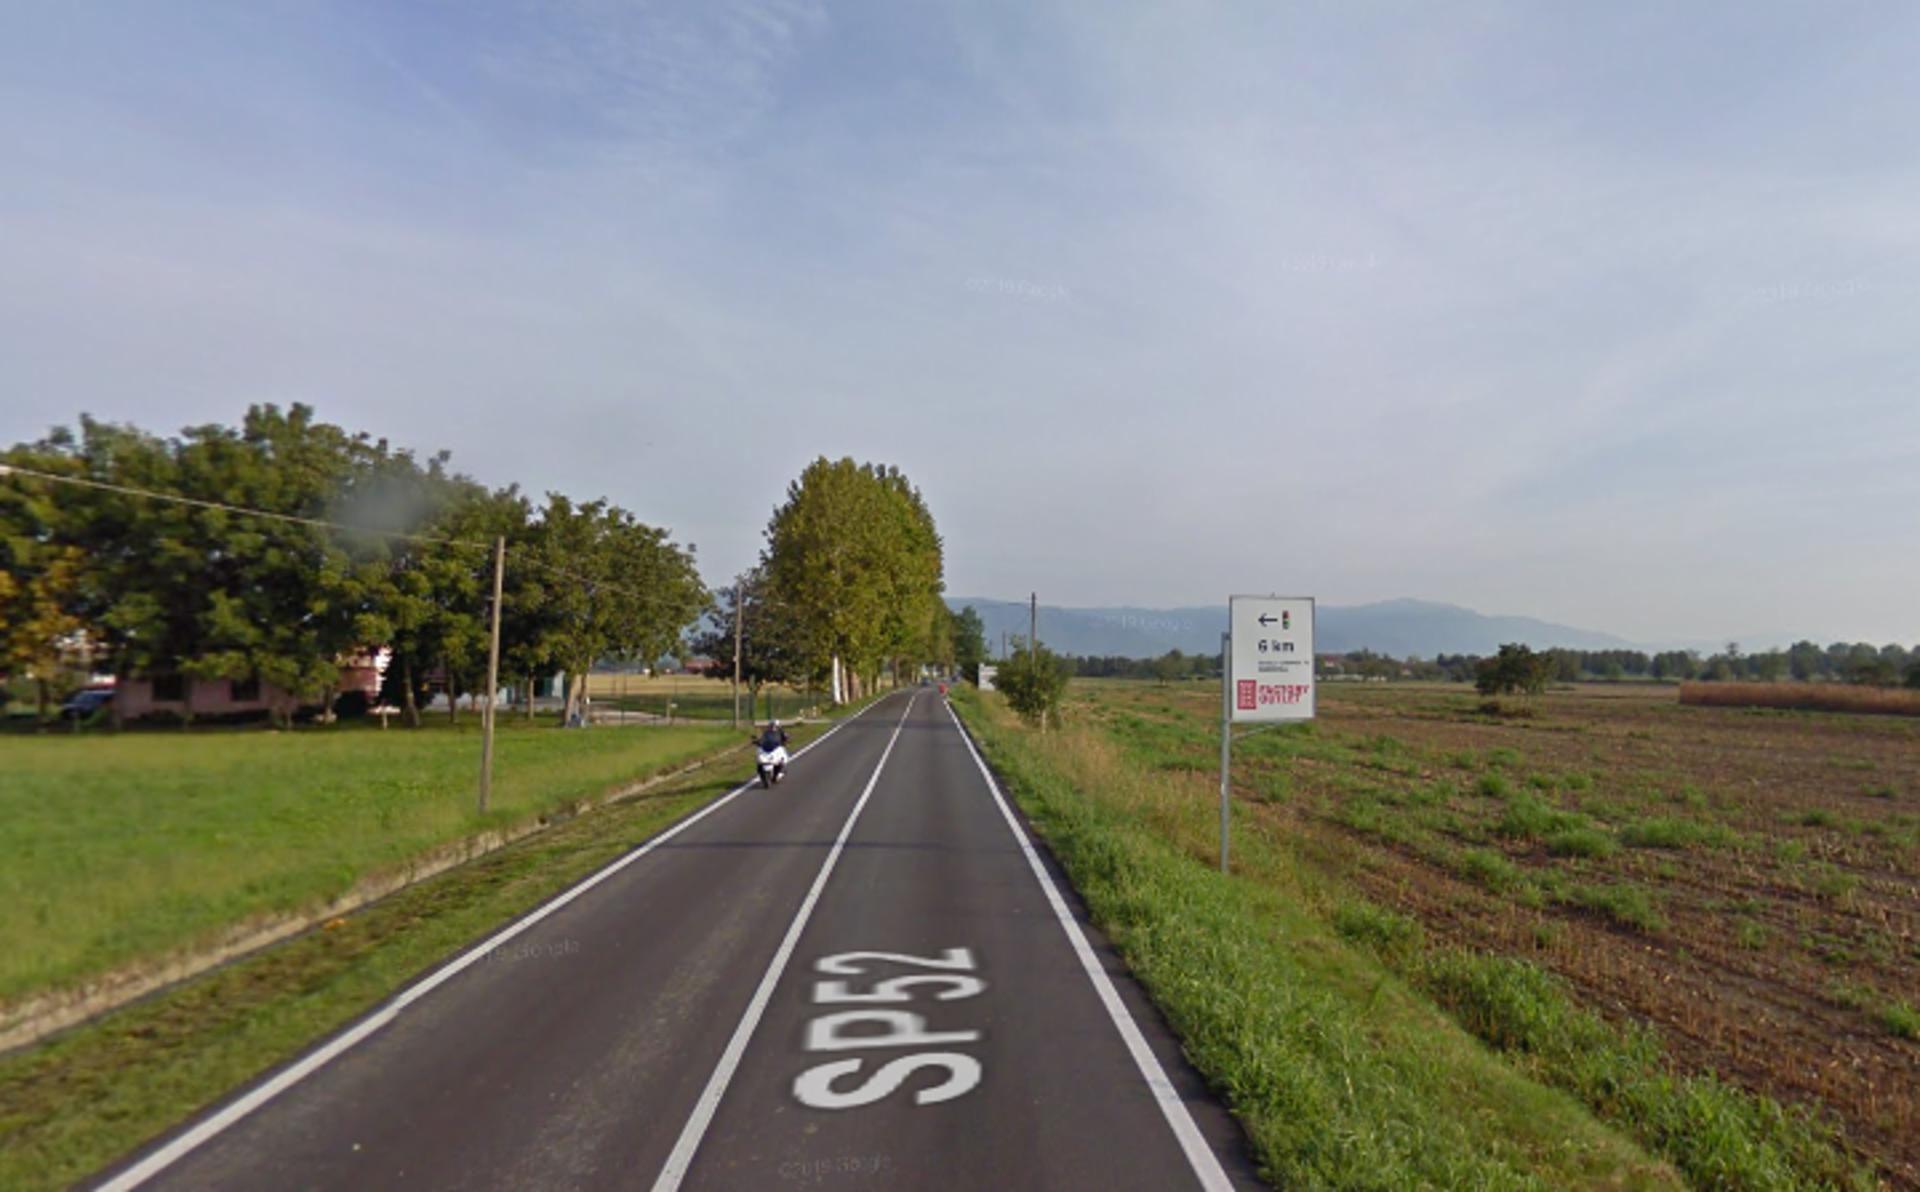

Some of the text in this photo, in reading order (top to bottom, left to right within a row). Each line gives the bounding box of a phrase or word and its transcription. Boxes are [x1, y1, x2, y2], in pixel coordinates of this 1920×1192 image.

[1258, 639, 1294, 653] 6 km
[793, 947, 987, 1109] SP52
